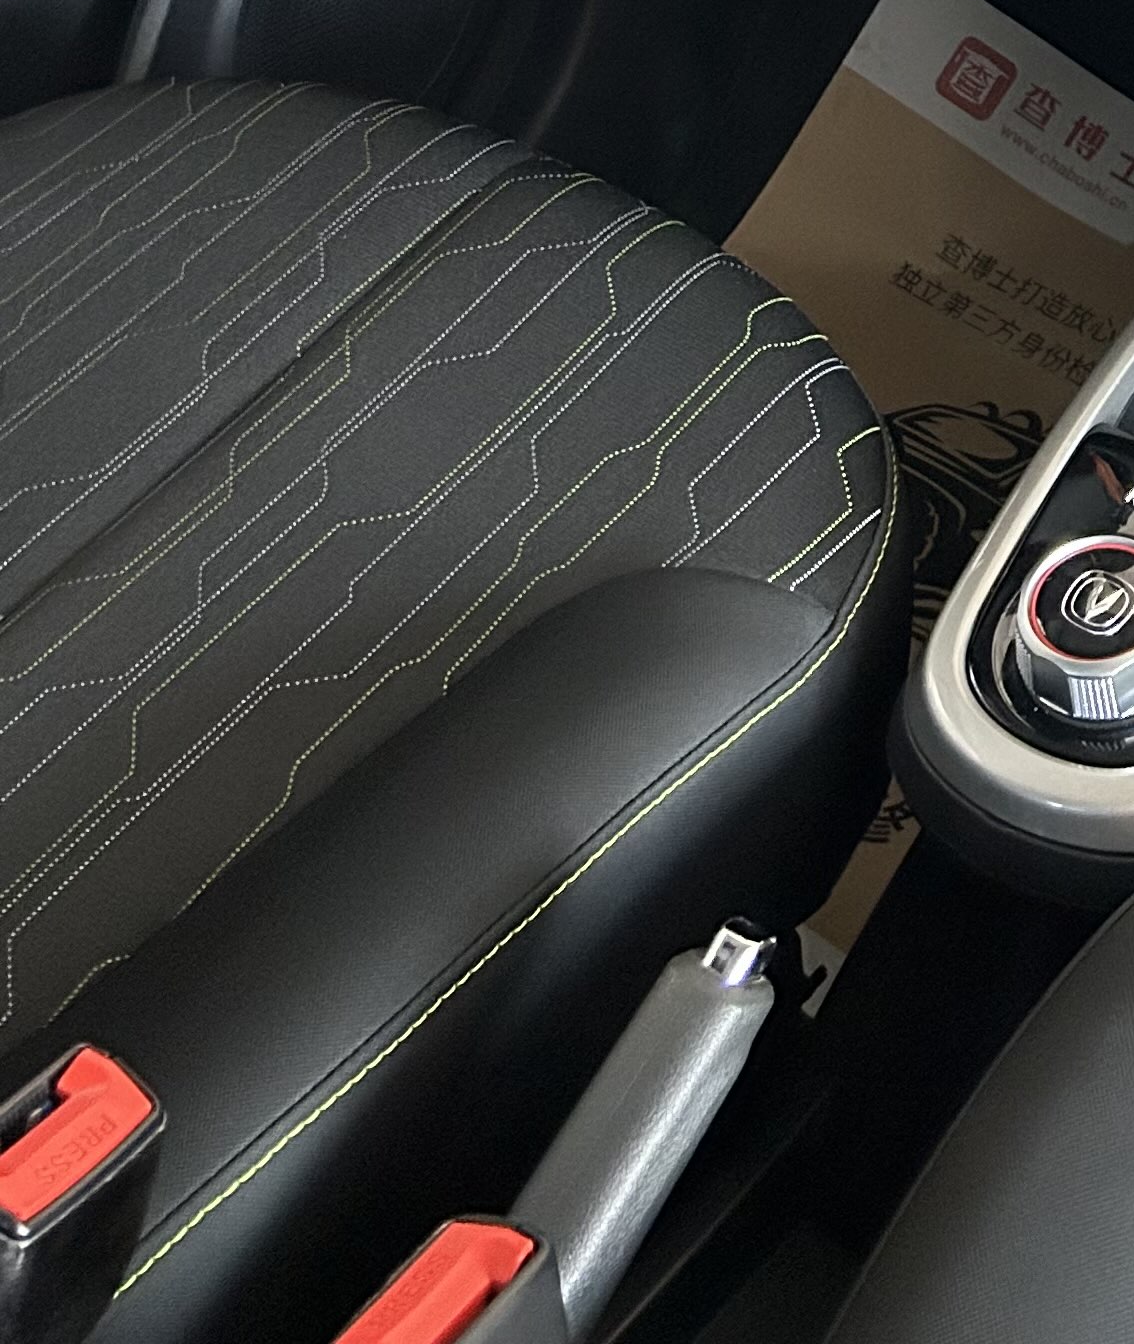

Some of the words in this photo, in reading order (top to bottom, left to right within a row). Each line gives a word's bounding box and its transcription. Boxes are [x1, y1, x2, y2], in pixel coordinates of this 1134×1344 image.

[1000, 124, 1128, 210] www.chaboshi.cn
[888, 260, 1099, 388] 独立第三方身份检
[935, 233, 1118, 344] 查博士打造放心
[34, 1113, 118, 1186] PRESS
